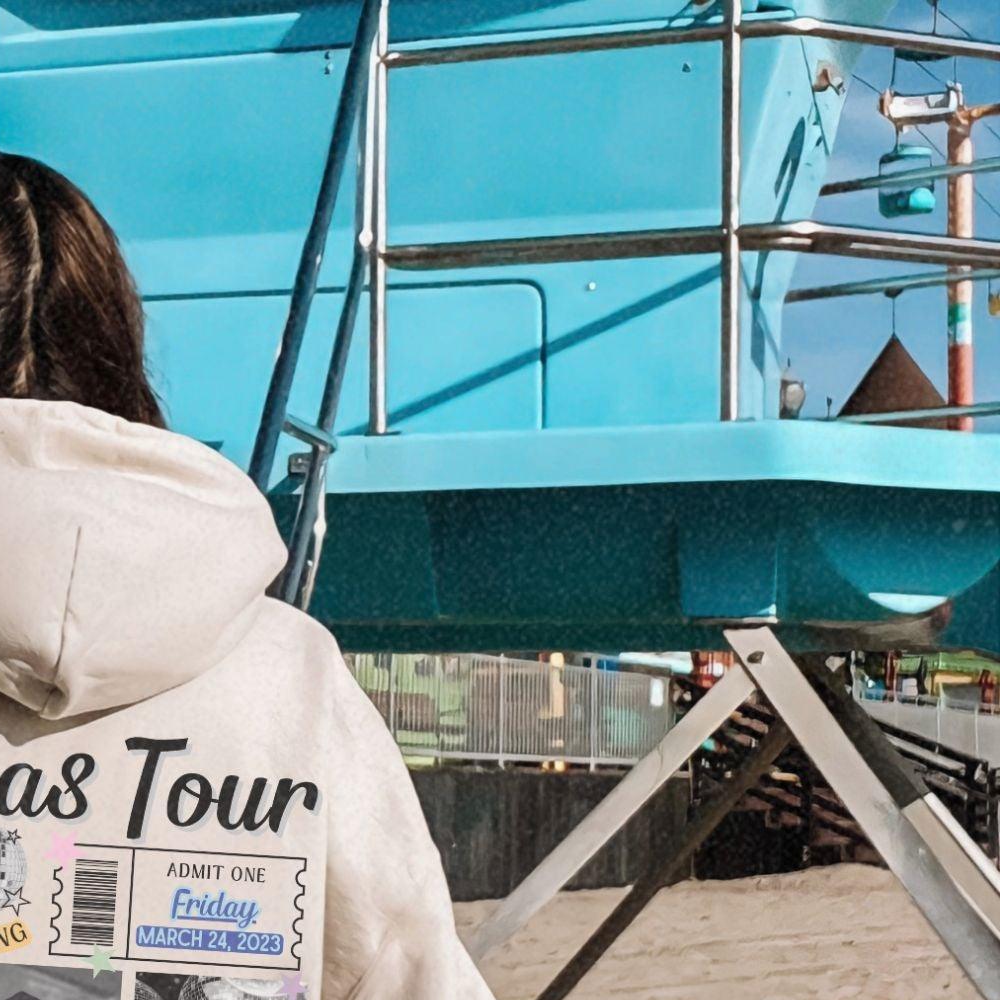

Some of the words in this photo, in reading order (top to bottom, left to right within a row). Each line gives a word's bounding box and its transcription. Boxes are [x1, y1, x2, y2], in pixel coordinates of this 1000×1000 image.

[125, 736, 319, 840] Tour
[166, 862, 225, 880] ADMIT
[231, 866, 266, 883] ONE
[137, 926, 202, 947] MARCH
[208, 931, 231, 952] 24,
[237, 933, 281, 952] 2023
